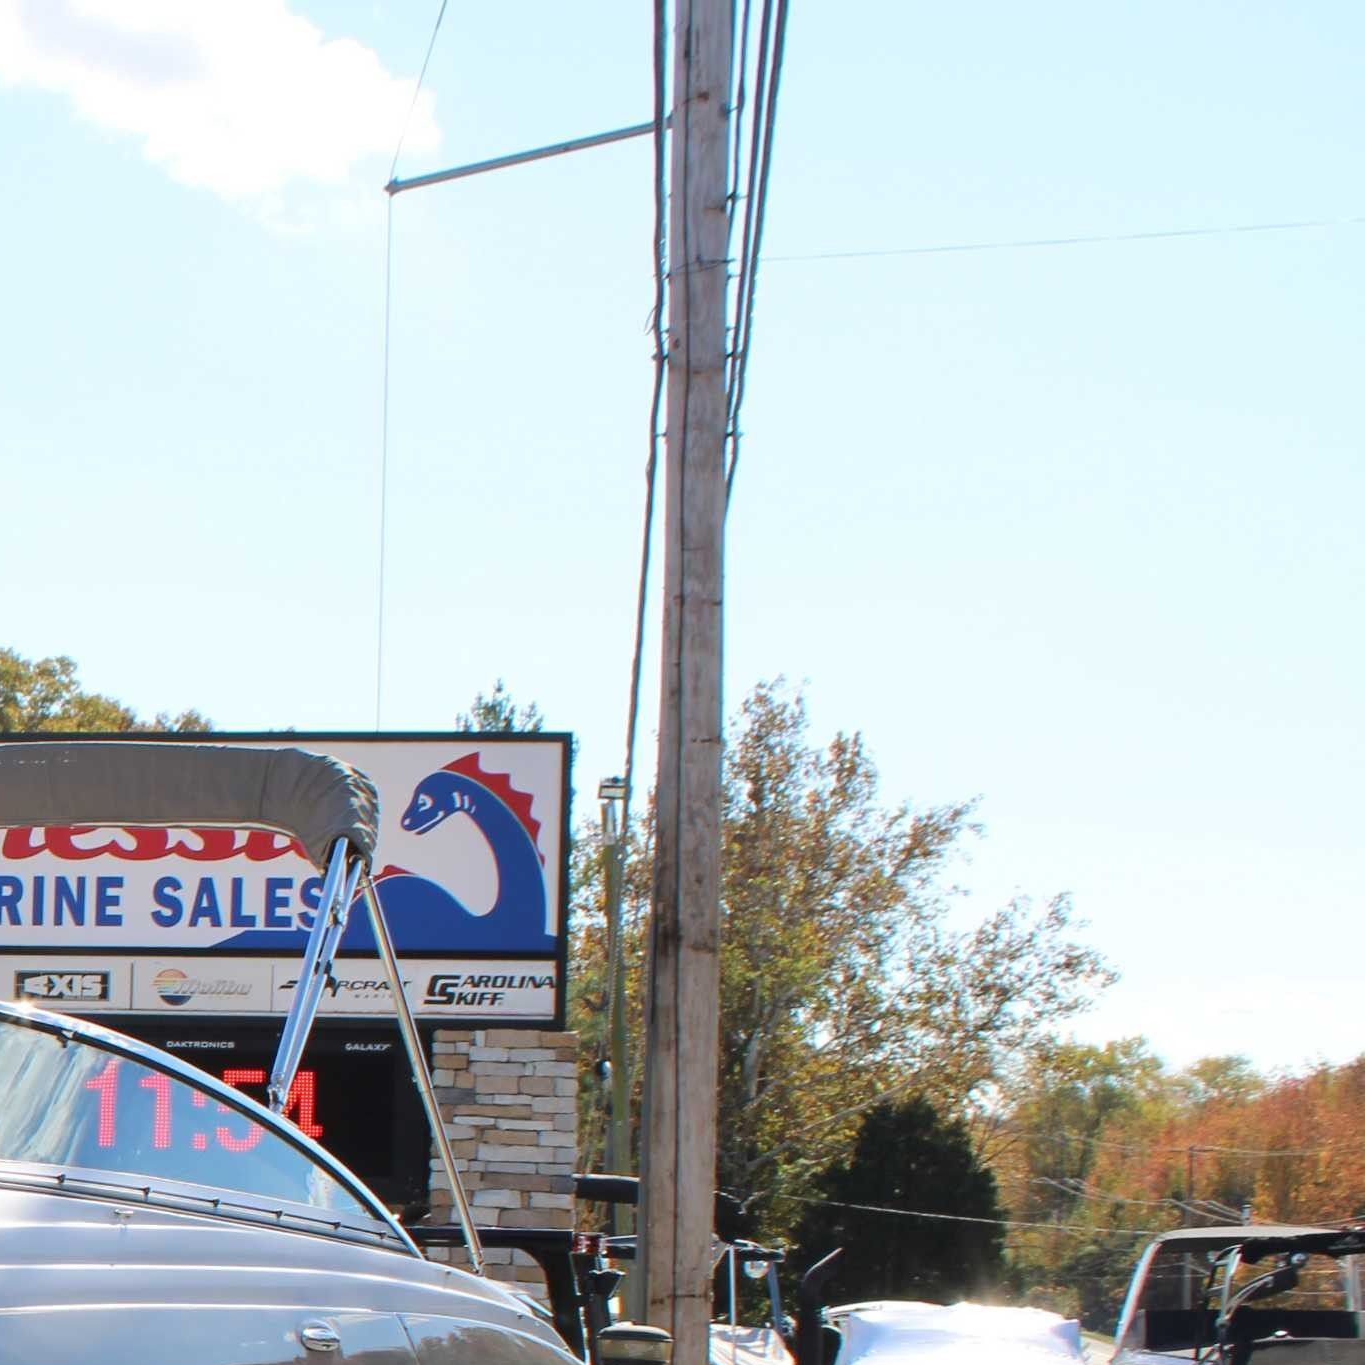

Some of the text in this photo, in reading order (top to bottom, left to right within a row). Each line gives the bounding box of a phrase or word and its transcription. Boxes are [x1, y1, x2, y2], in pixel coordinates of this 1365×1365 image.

[150, 876, 325, 929] SALES
[23, 973, 103, 998] AXIS
[344, 1042, 391, 1051] GALAXY
